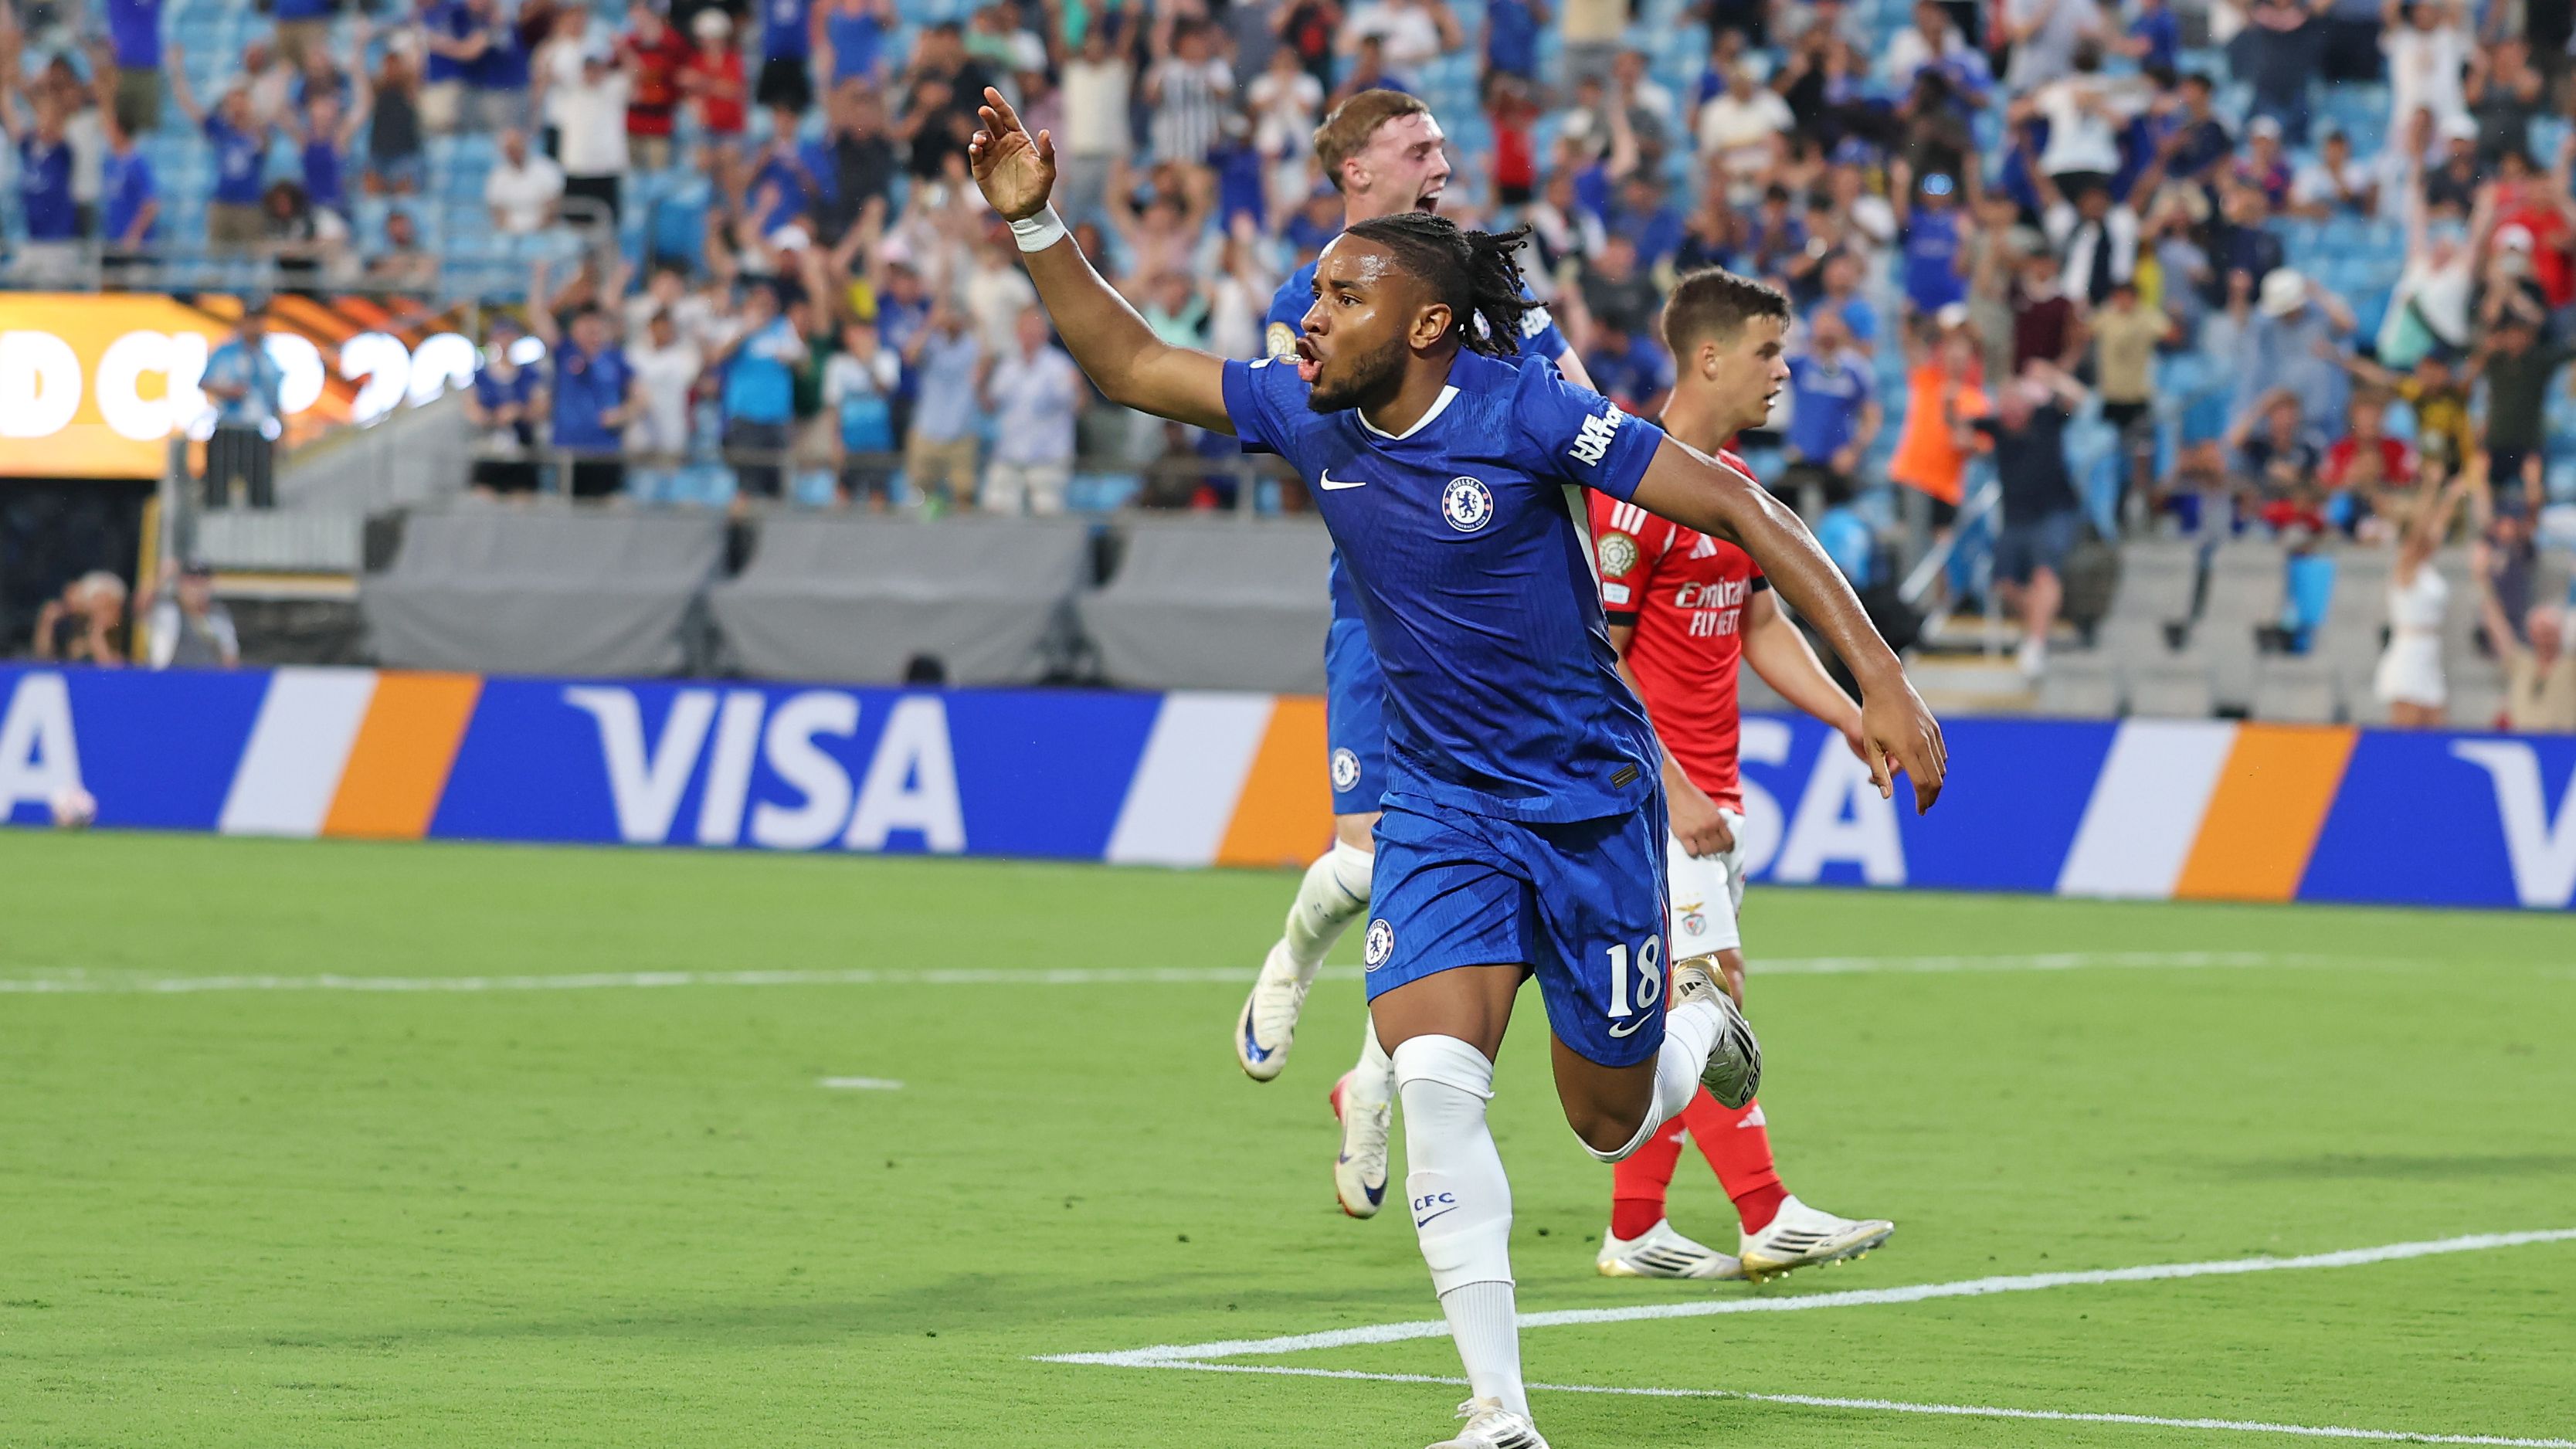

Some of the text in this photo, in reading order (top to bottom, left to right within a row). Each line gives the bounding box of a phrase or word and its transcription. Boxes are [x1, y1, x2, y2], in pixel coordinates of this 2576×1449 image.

[1568, 413, 1604, 460] LIVE
[1449, 479, 1480, 492] CHELSEA
[1688, 611, 1718, 637] FLY
[562, 684, 969, 853] VISA
[1607, 935, 1661, 1017] 18
[1414, 1193, 1455, 1211] CFC
